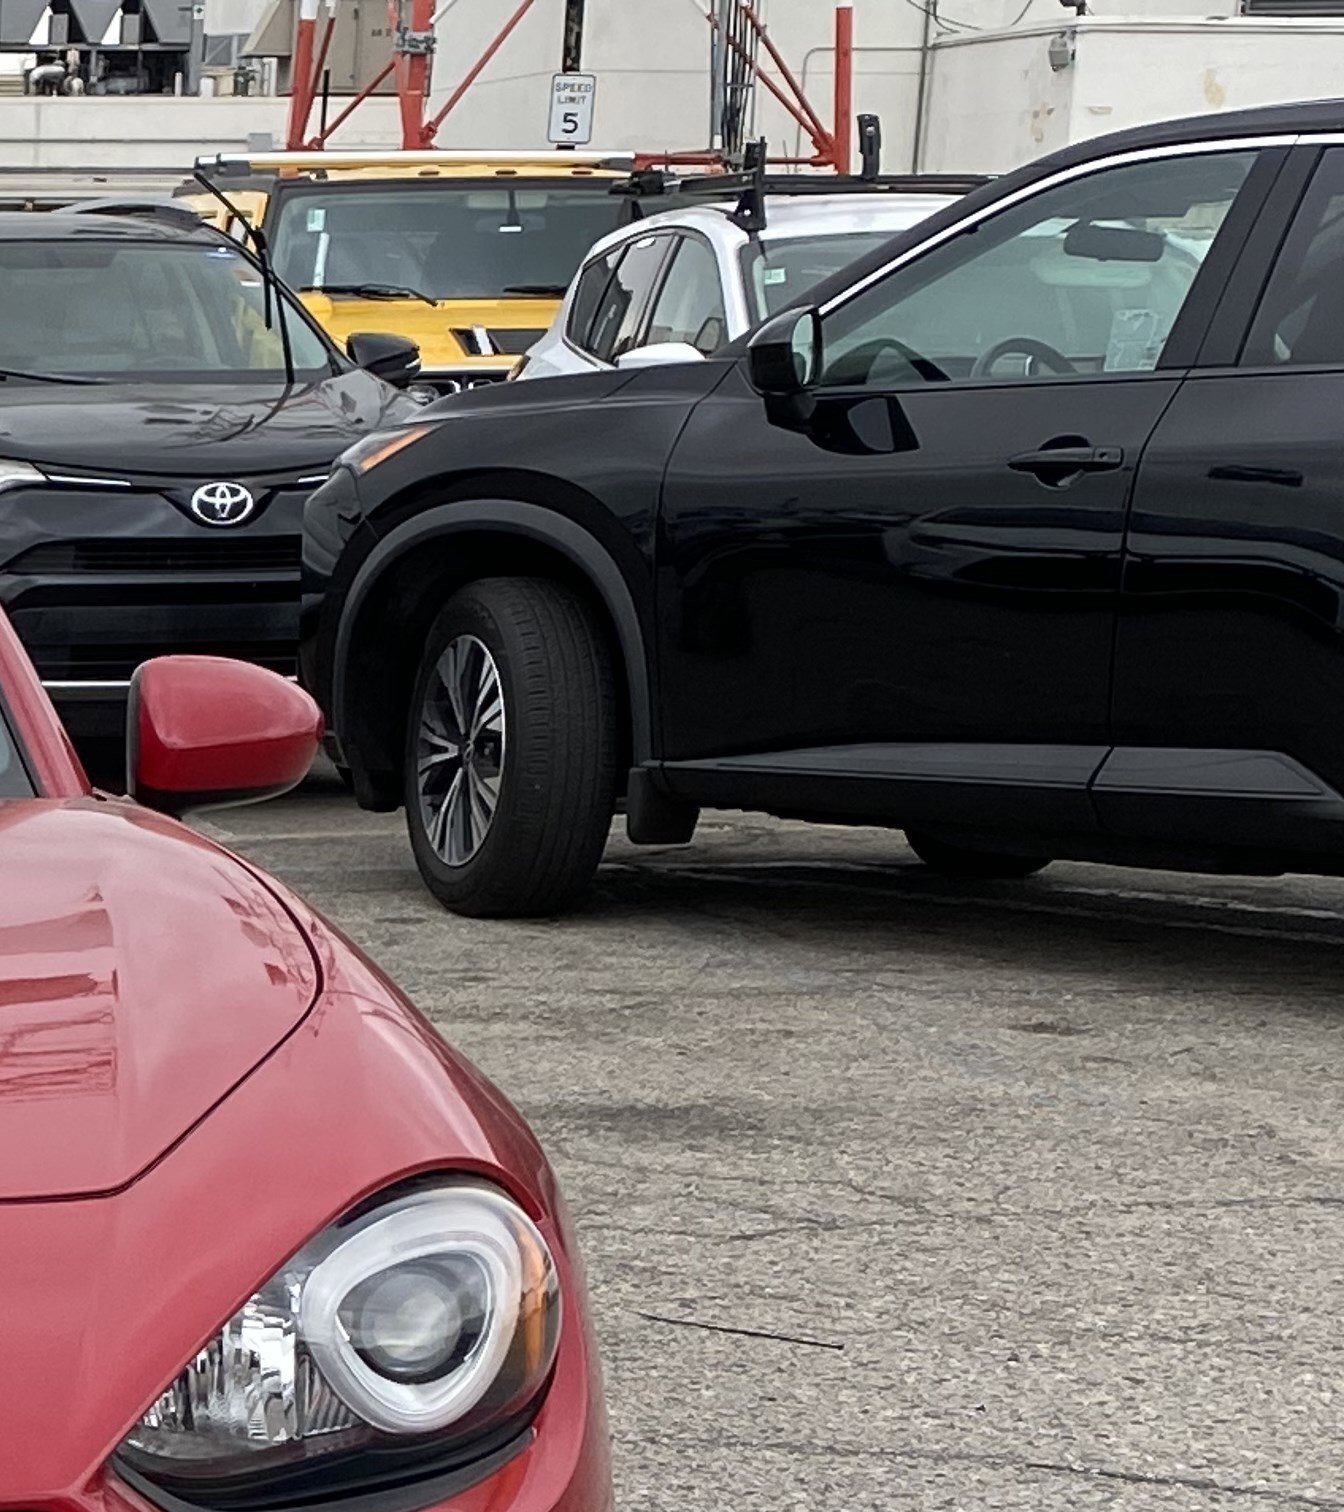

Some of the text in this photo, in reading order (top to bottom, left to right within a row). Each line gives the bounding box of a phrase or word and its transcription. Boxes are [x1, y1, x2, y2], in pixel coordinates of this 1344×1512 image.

[555, 82, 592, 93] SPEED
[557, 95, 587, 105] LIMIT
[561, 112, 579, 134] 5
